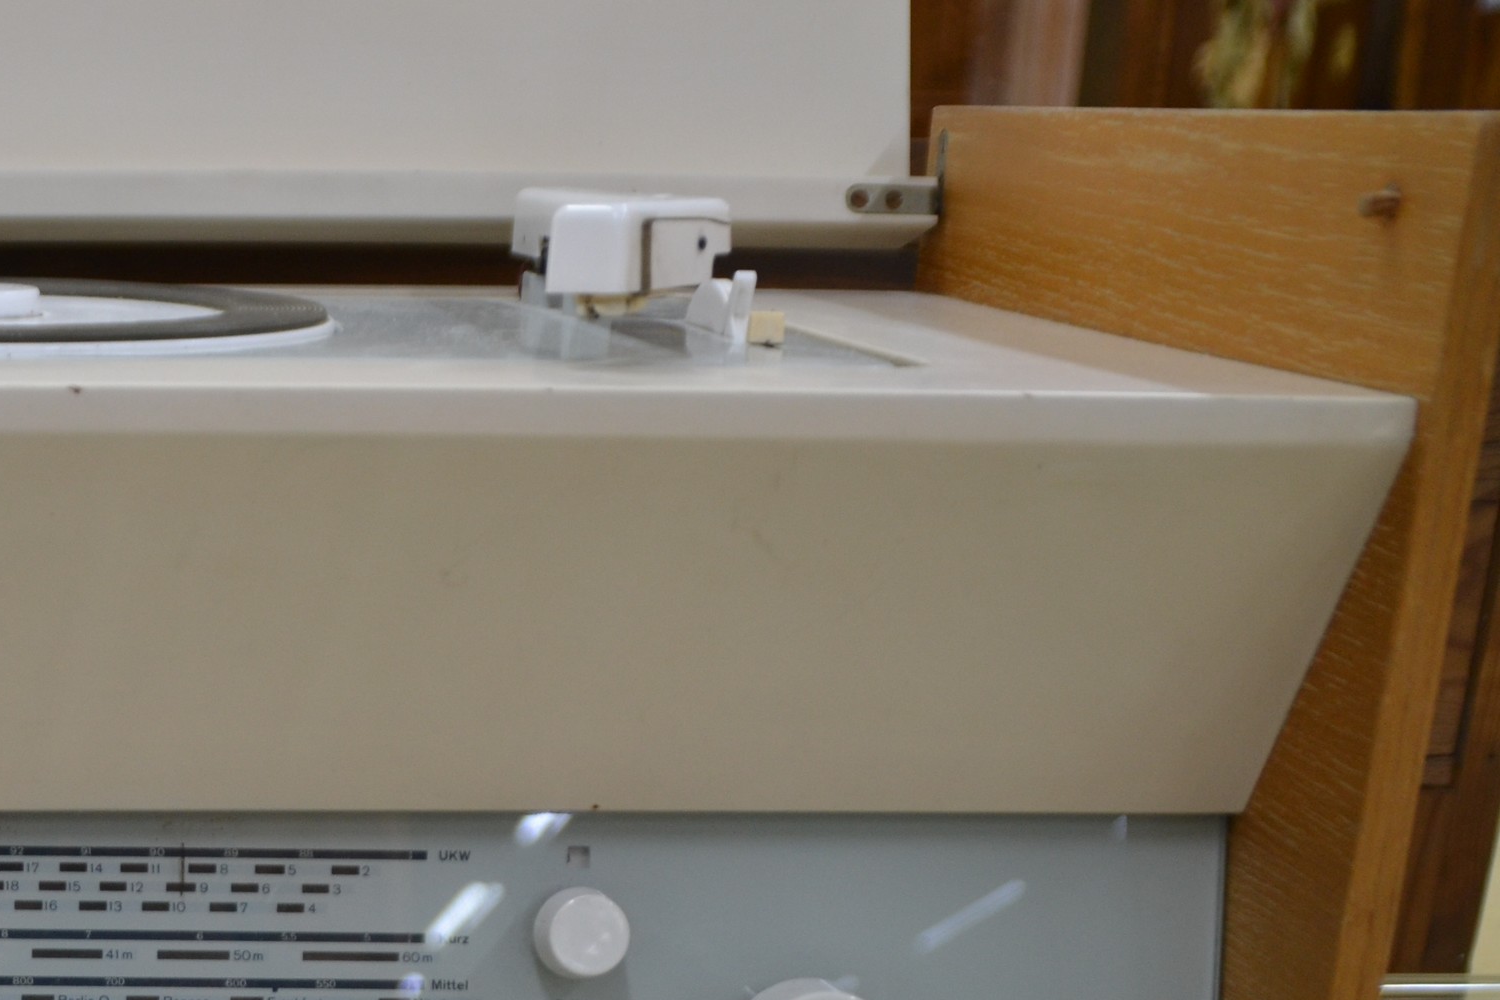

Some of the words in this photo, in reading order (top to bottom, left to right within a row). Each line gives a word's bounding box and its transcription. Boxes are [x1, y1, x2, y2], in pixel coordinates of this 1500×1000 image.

[438, 849, 471, 861] UKW
[25, 861, 39, 872] 17
[362, 866, 371, 876] 2
[332, 885, 341, 895] 3
[431, 978, 468, 990] Mittel
